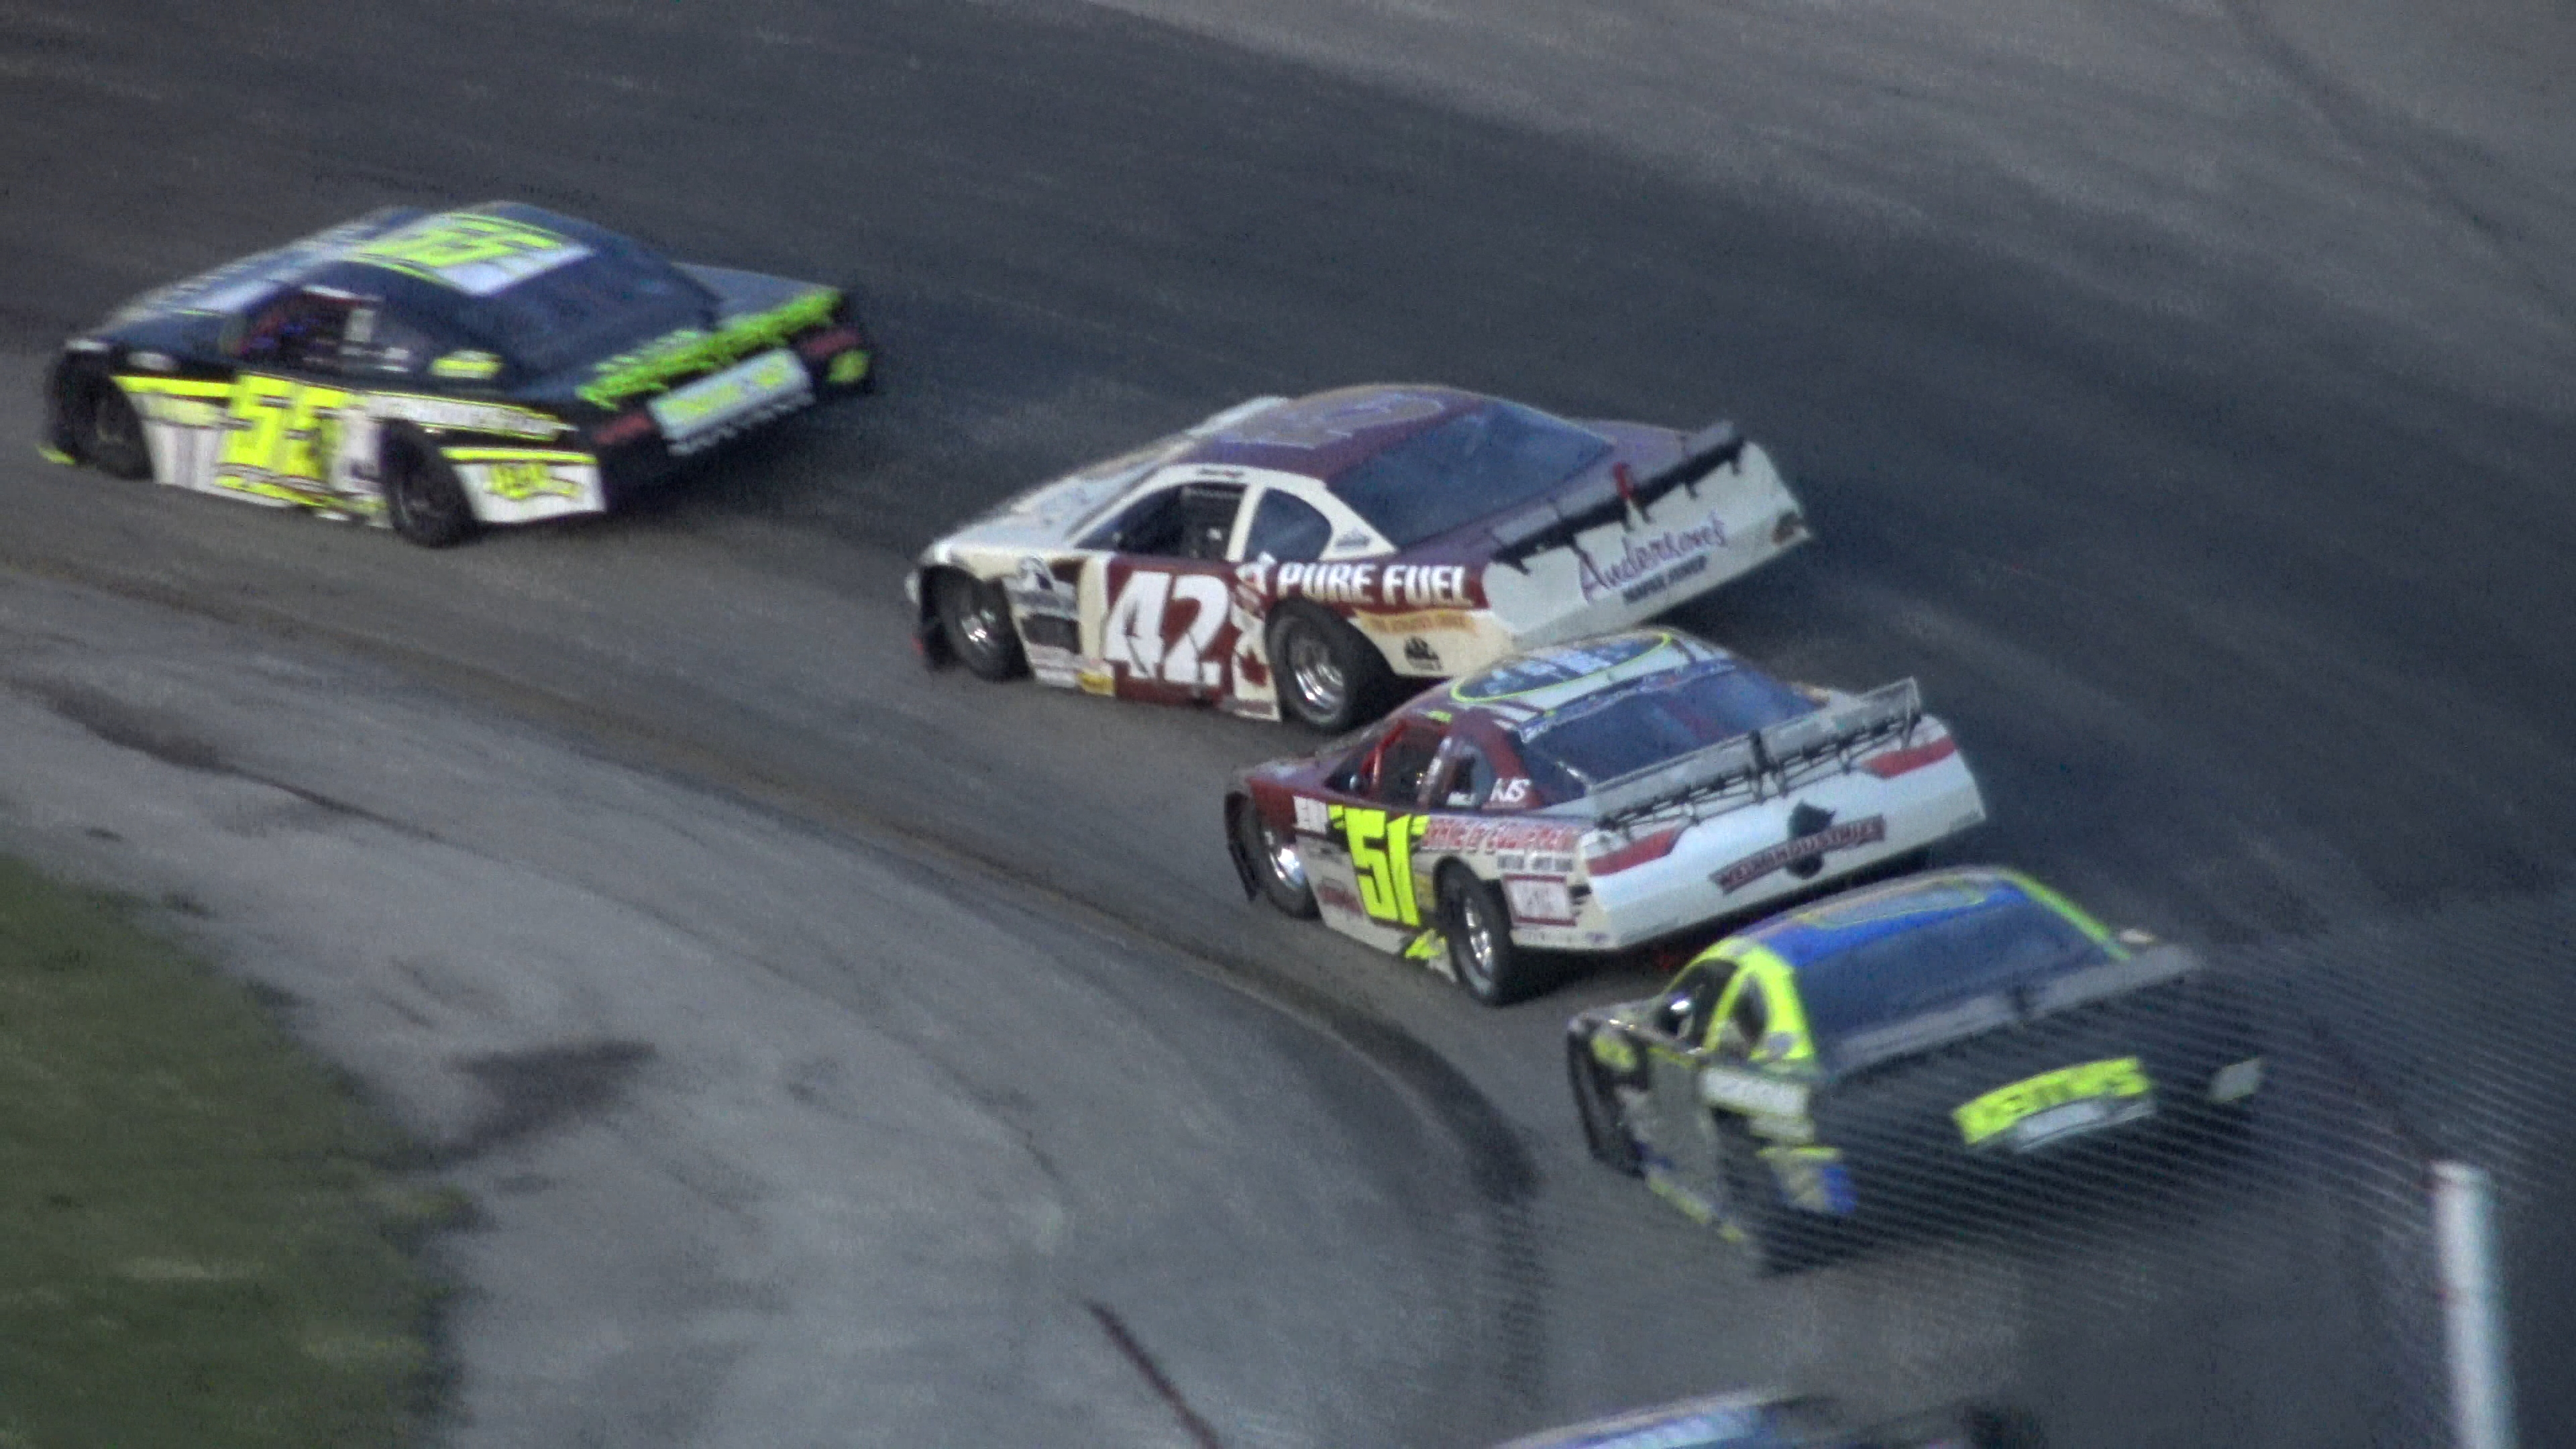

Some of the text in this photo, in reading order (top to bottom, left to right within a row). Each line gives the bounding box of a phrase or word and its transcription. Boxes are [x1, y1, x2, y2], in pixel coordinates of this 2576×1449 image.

[1102, 570, 1233, 688] 42
[1275, 562, 1474, 606] PURE FUEL
[1344, 807, 1421, 928] 51
